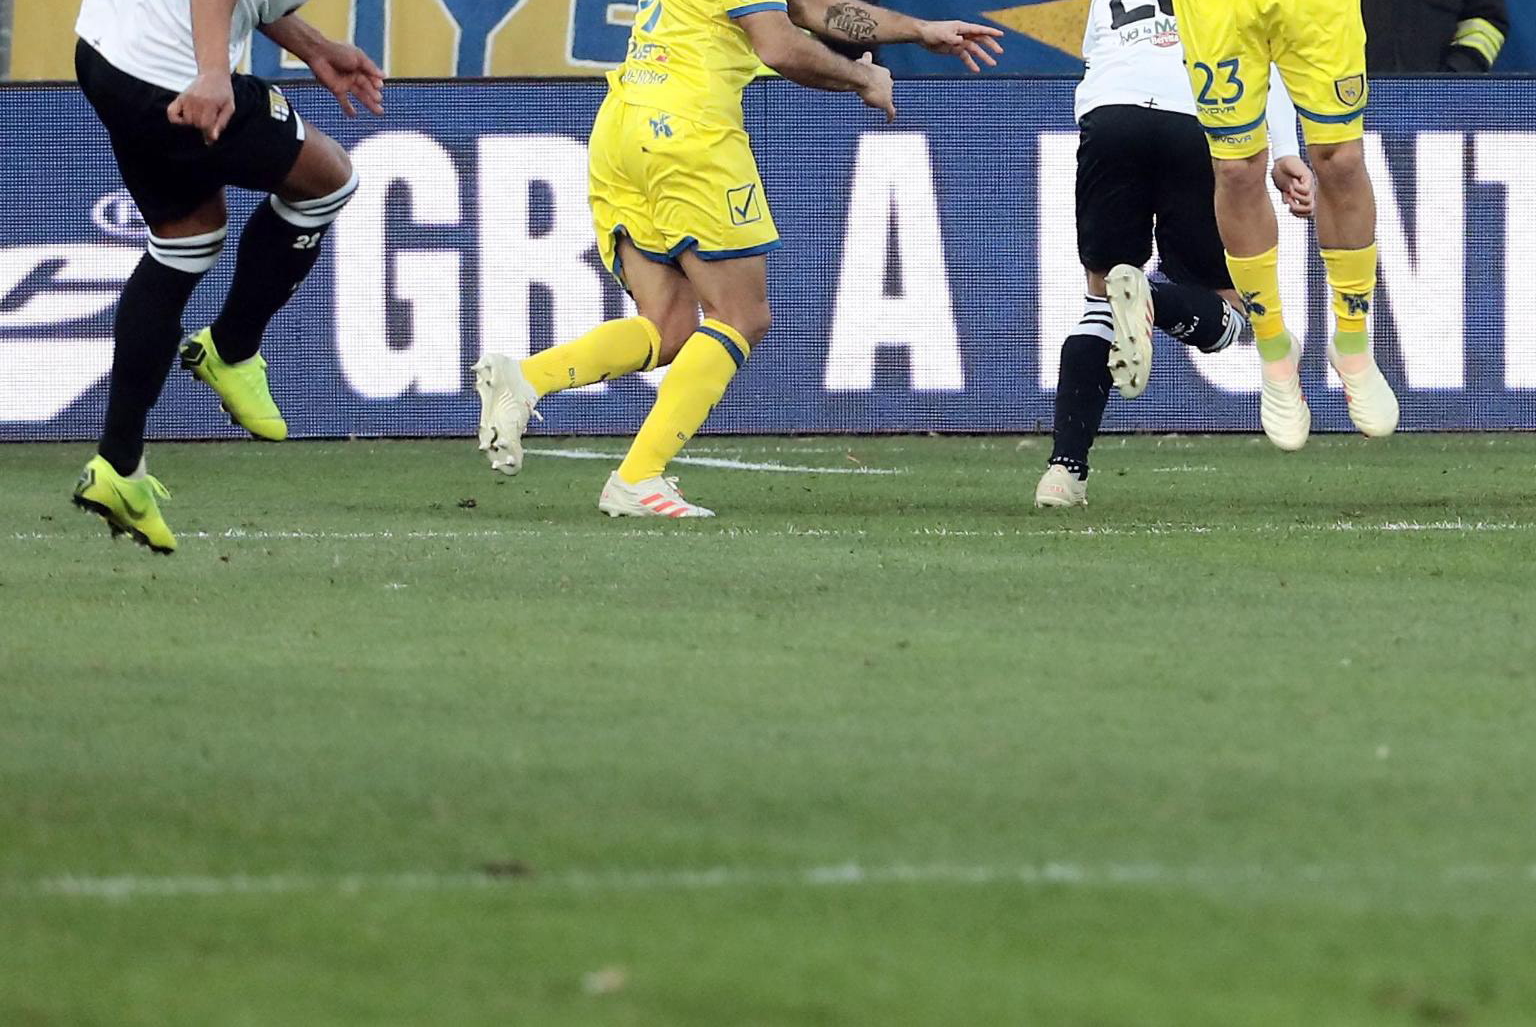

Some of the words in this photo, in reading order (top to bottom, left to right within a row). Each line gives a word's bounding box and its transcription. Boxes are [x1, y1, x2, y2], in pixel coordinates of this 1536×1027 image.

[1194, 58, 1244, 105] 23
[335, 130, 705, 398] GR
[823, 132, 965, 390] A
